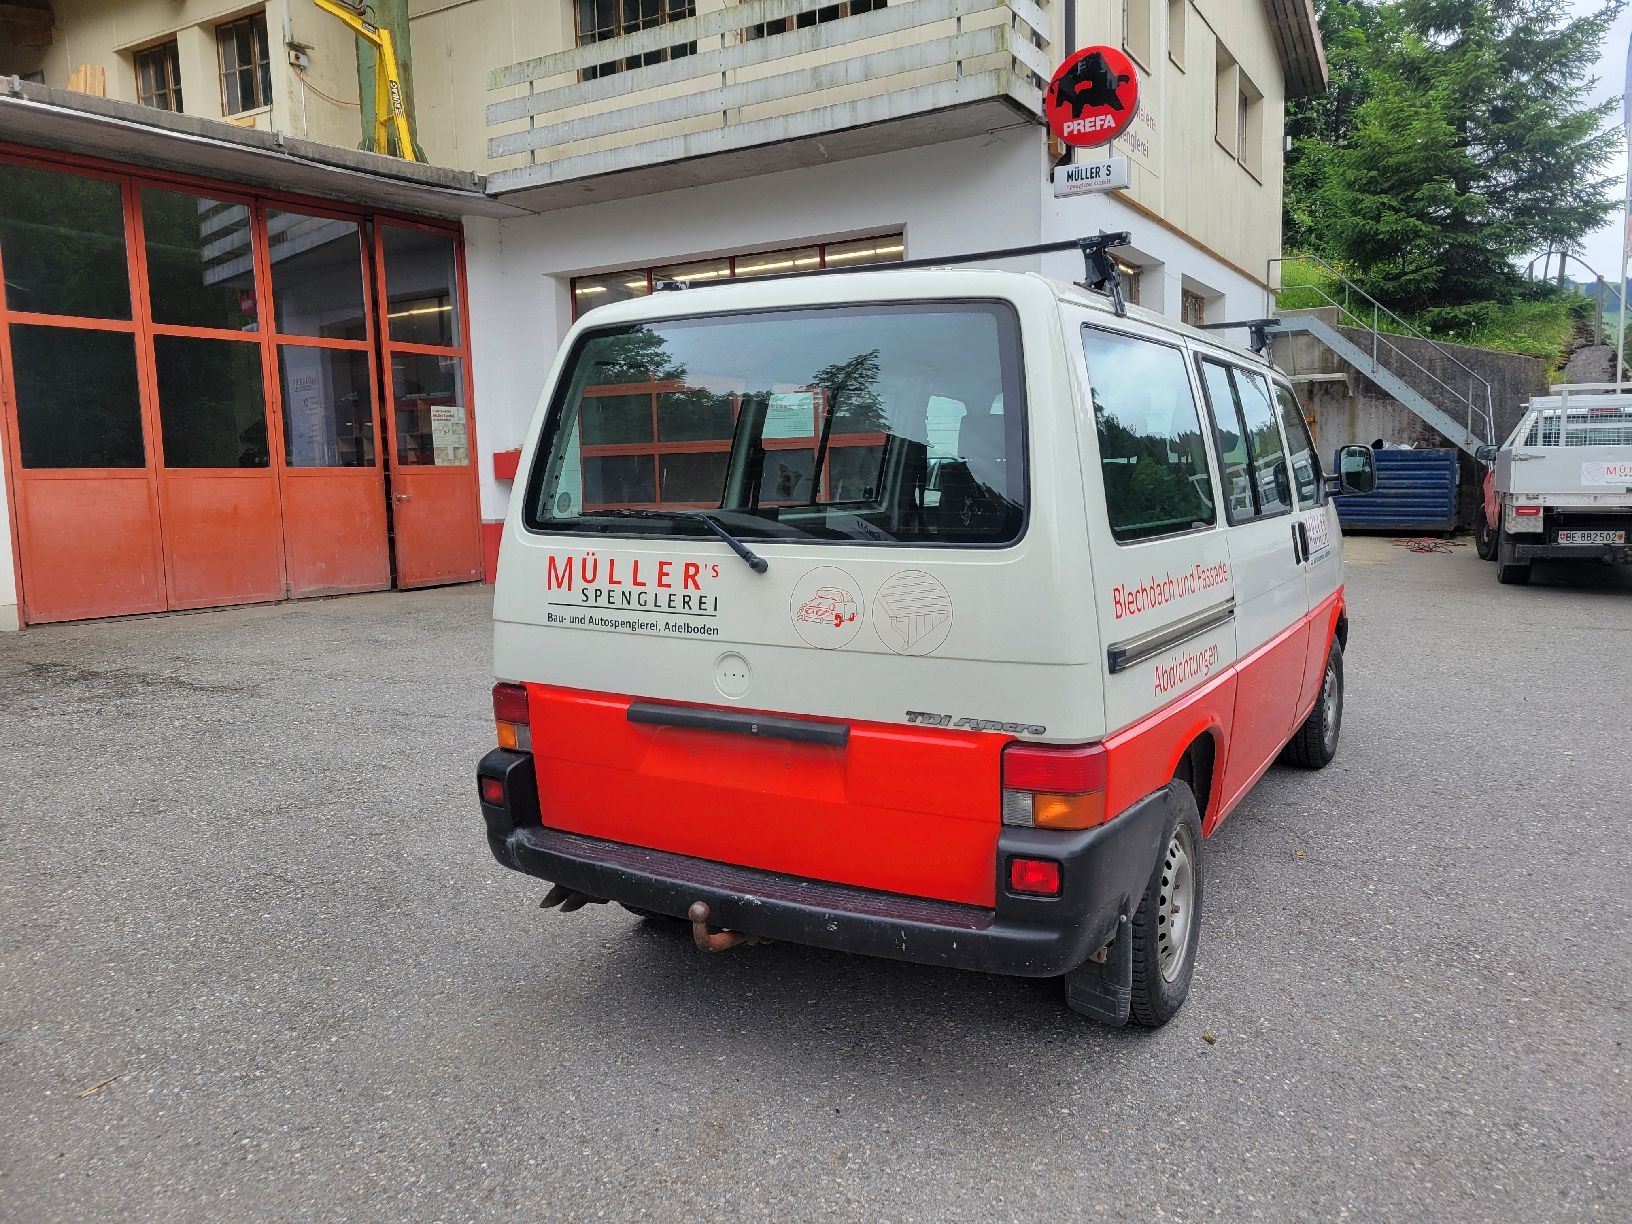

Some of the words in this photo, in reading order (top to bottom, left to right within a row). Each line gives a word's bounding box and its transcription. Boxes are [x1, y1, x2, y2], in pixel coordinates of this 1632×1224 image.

[1063, 114, 1116, 136] PREFA
[581, 587, 718, 612] SPENGLEREI
[1113, 571, 1176, 619] Blechdach
[1176, 564, 1196, 598] und
[1195, 560, 1228, 591] Fassade
[547, 612, 567, 623] Bau-
[569, 614, 586, 625] und
[588, 616, 661, 632] Autospenglerei,
[664, 621, 719, 636] Adelboden
[1154, 643, 1219, 697] Abdichtungen
[905, 710, 952, 726] TDI
